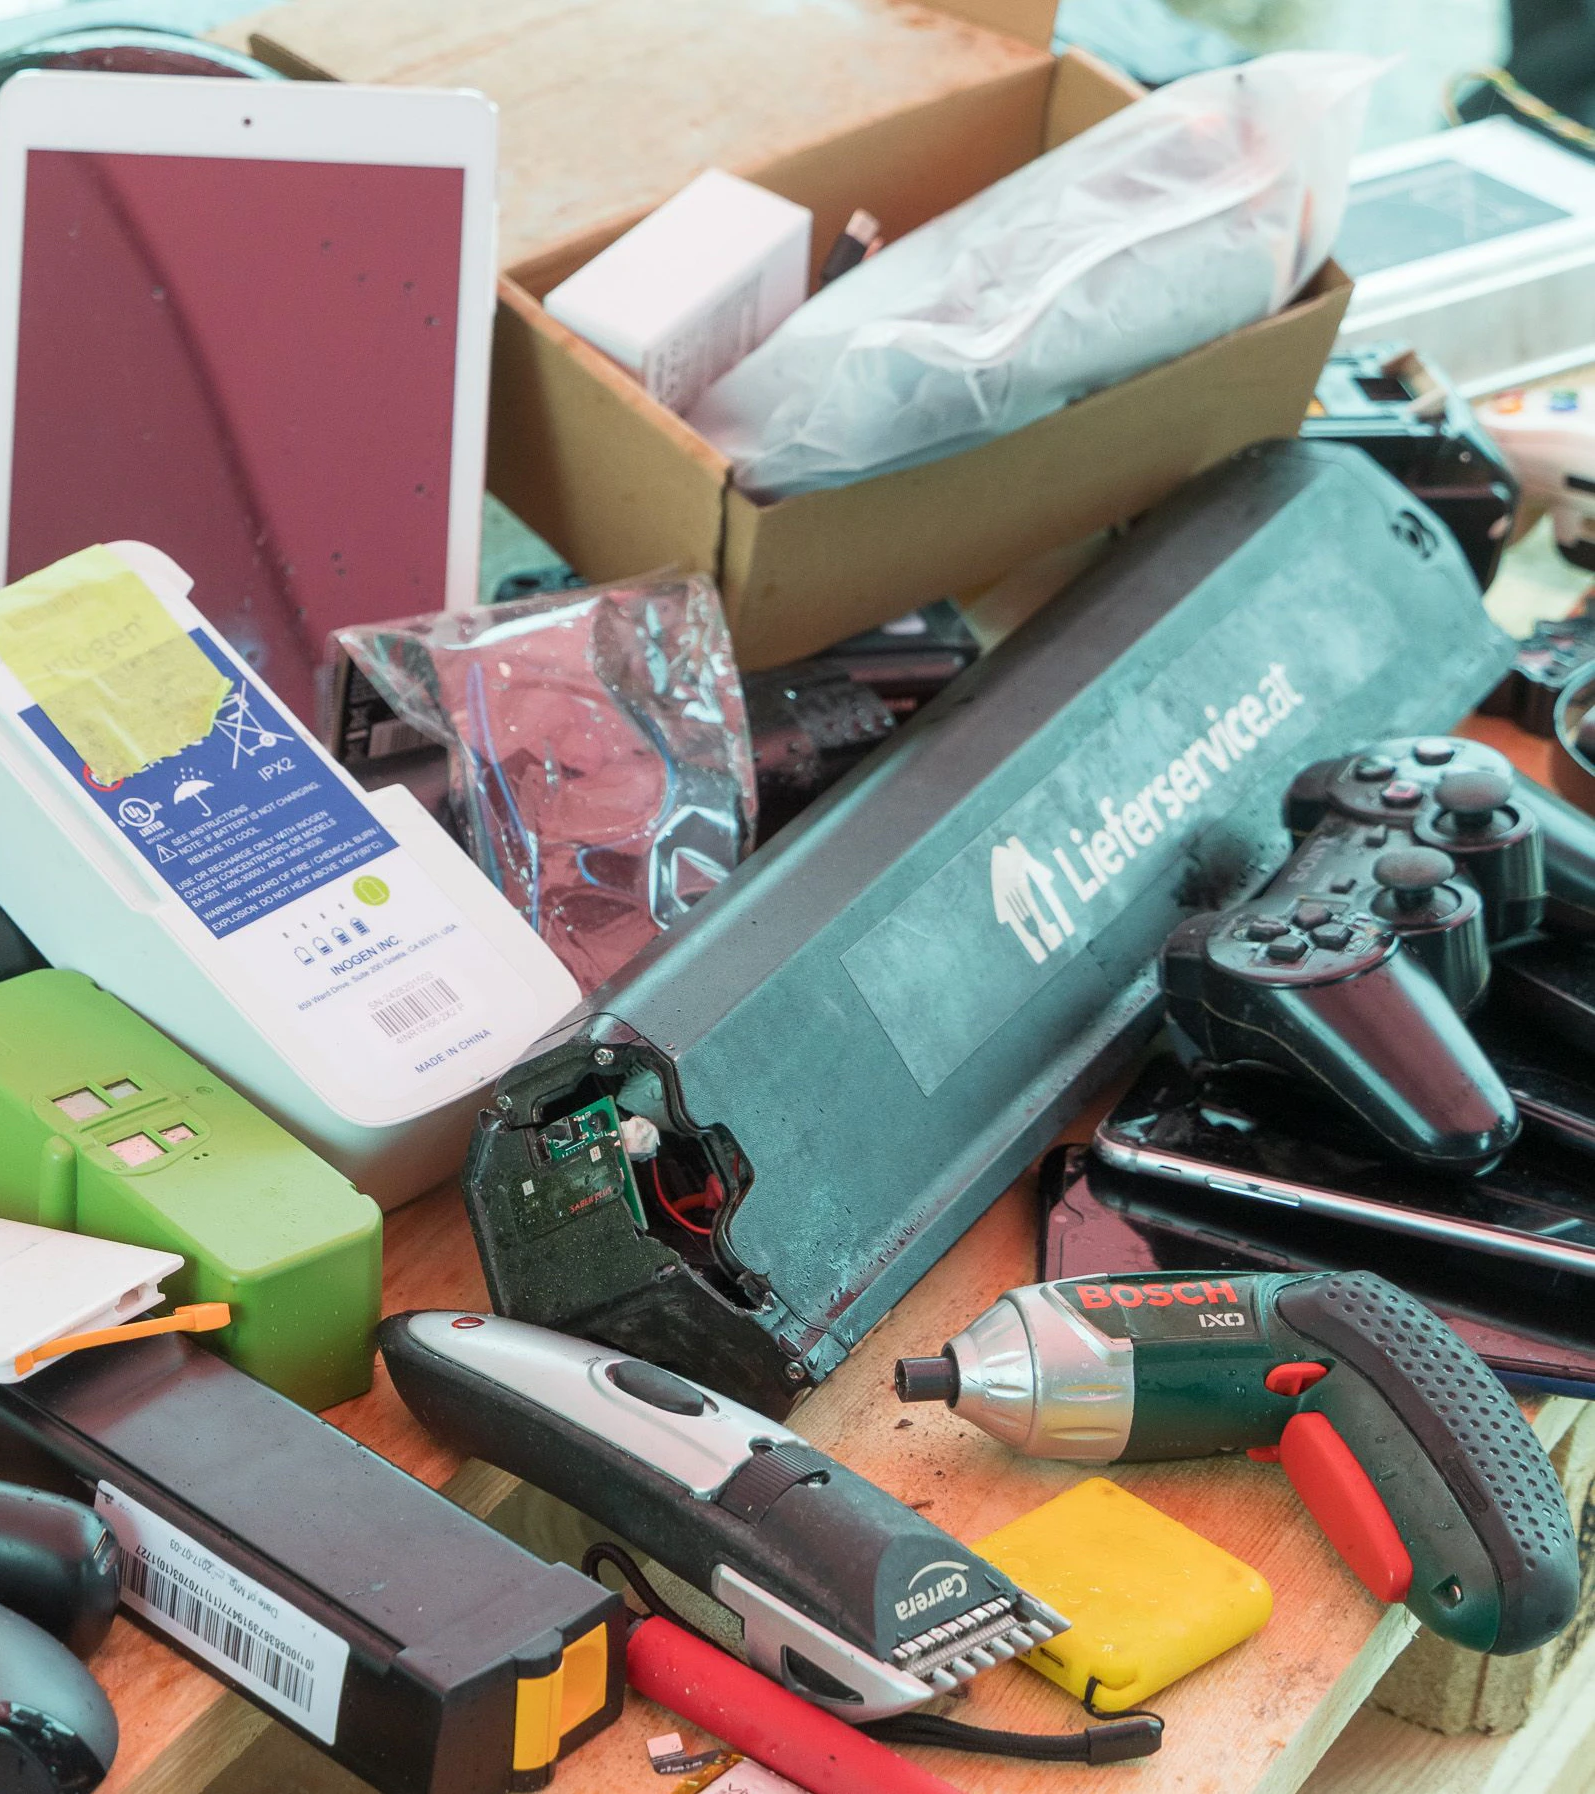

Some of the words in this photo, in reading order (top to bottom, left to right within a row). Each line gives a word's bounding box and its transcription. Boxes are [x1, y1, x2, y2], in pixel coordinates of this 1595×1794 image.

[258, 758, 295, 781] IPX2
[1052, 661, 1305, 904] Lieferservice.at
[172, 834, 189, 846] SEE
[189, 804, 248, 837] INSTRUCTIONS
[204, 834, 214, 843] IF
[213, 818, 249, 838] BATTERY
[250, 812, 259, 820] IS
[258, 804, 277, 816] NOT
[177, 878, 195, 890] USE
[195, 872, 208, 881] OR
[208, 848, 253, 874] RECHARGE
[253, 838, 275, 851] ONLY
[275, 826, 297, 840] WITH
[296, 810, 328, 830] INOGEN
[185, 878, 219, 898] OXYGEN
[219, 842, 289, 881] CONCENTRATORS
[289, 836, 302, 845] OR
[302, 818, 336, 839] MODELS
[188, 844, 223, 865] REMOVE
[223, 838, 236, 848] TO
[267, 858, 285, 869] AND
[204, 897, 242, 919] WARNING
[246, 878, 279, 898] HAZARD
[279, 872, 291, 881] OF
[291, 862, 310, 875] FIRE
[314, 840, 354, 864] CHEMICAL
[353, 828, 377, 844] BURN
[260, 896, 274, 905] DO
[274, 888, 291, 900] NOT
[291, 878, 311, 890] HEAT
[311, 864, 339, 880] ABOVE
[330, 947, 378, 975] INOGEN
[377, 934, 402, 951] INC.
[408, 943, 420, 951] CA
[441, 923, 456, 934] USA
[415, 1053, 446, 1073] MADE
[446, 1046, 458, 1056] IN
[458, 1028, 492, 1049] CHINA
[1075, 1281, 1238, 1310] BOSCH
[1198, 1312, 1246, 1328] IXO
[169, 1538, 212, 1574] 2017-07-03
[258, 1597, 279, 1619] Date
[894, 1572, 967, 1621] Carrera
